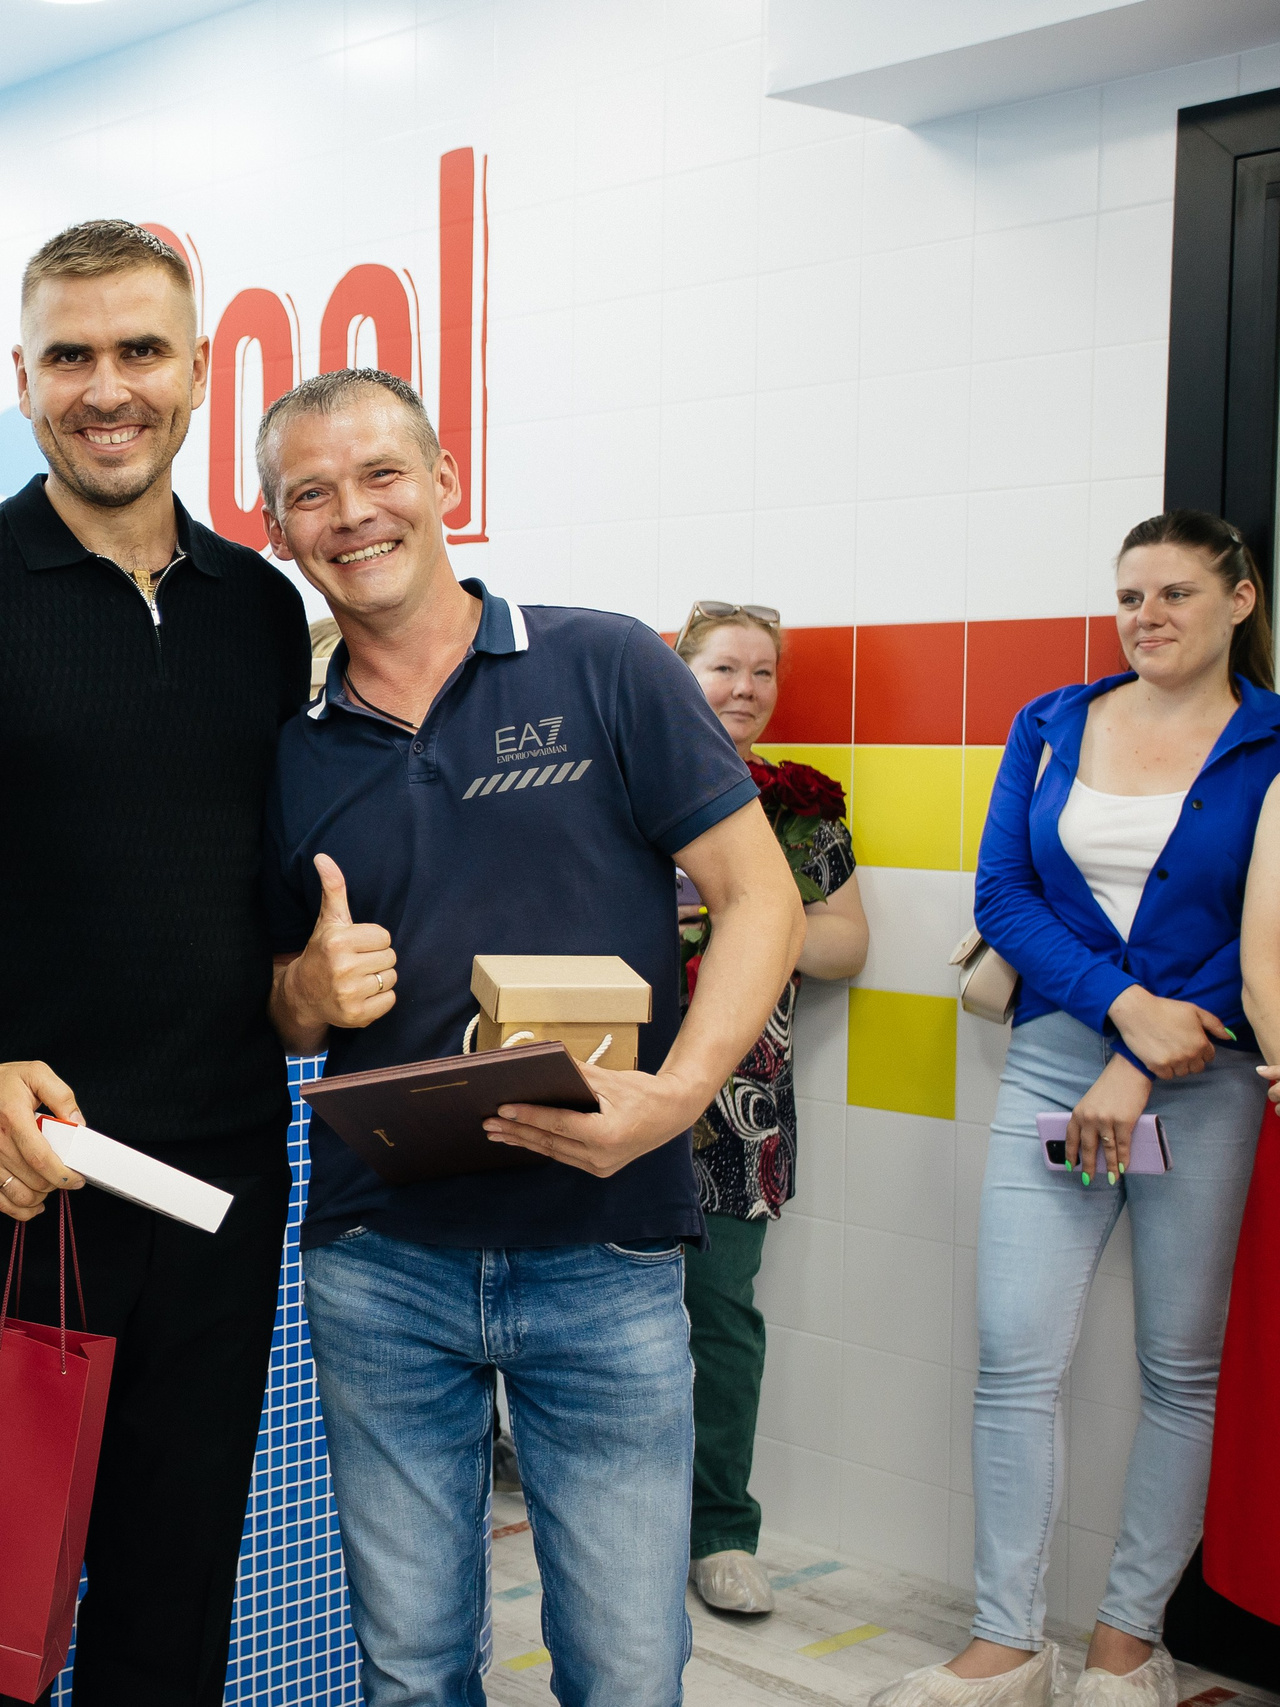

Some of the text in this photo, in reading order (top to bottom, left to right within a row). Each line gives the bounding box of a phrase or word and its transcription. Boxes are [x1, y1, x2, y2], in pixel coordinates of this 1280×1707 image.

[495, 716, 564, 755] EA7
[496, 744, 568, 764] EMPORIO ARMANI
